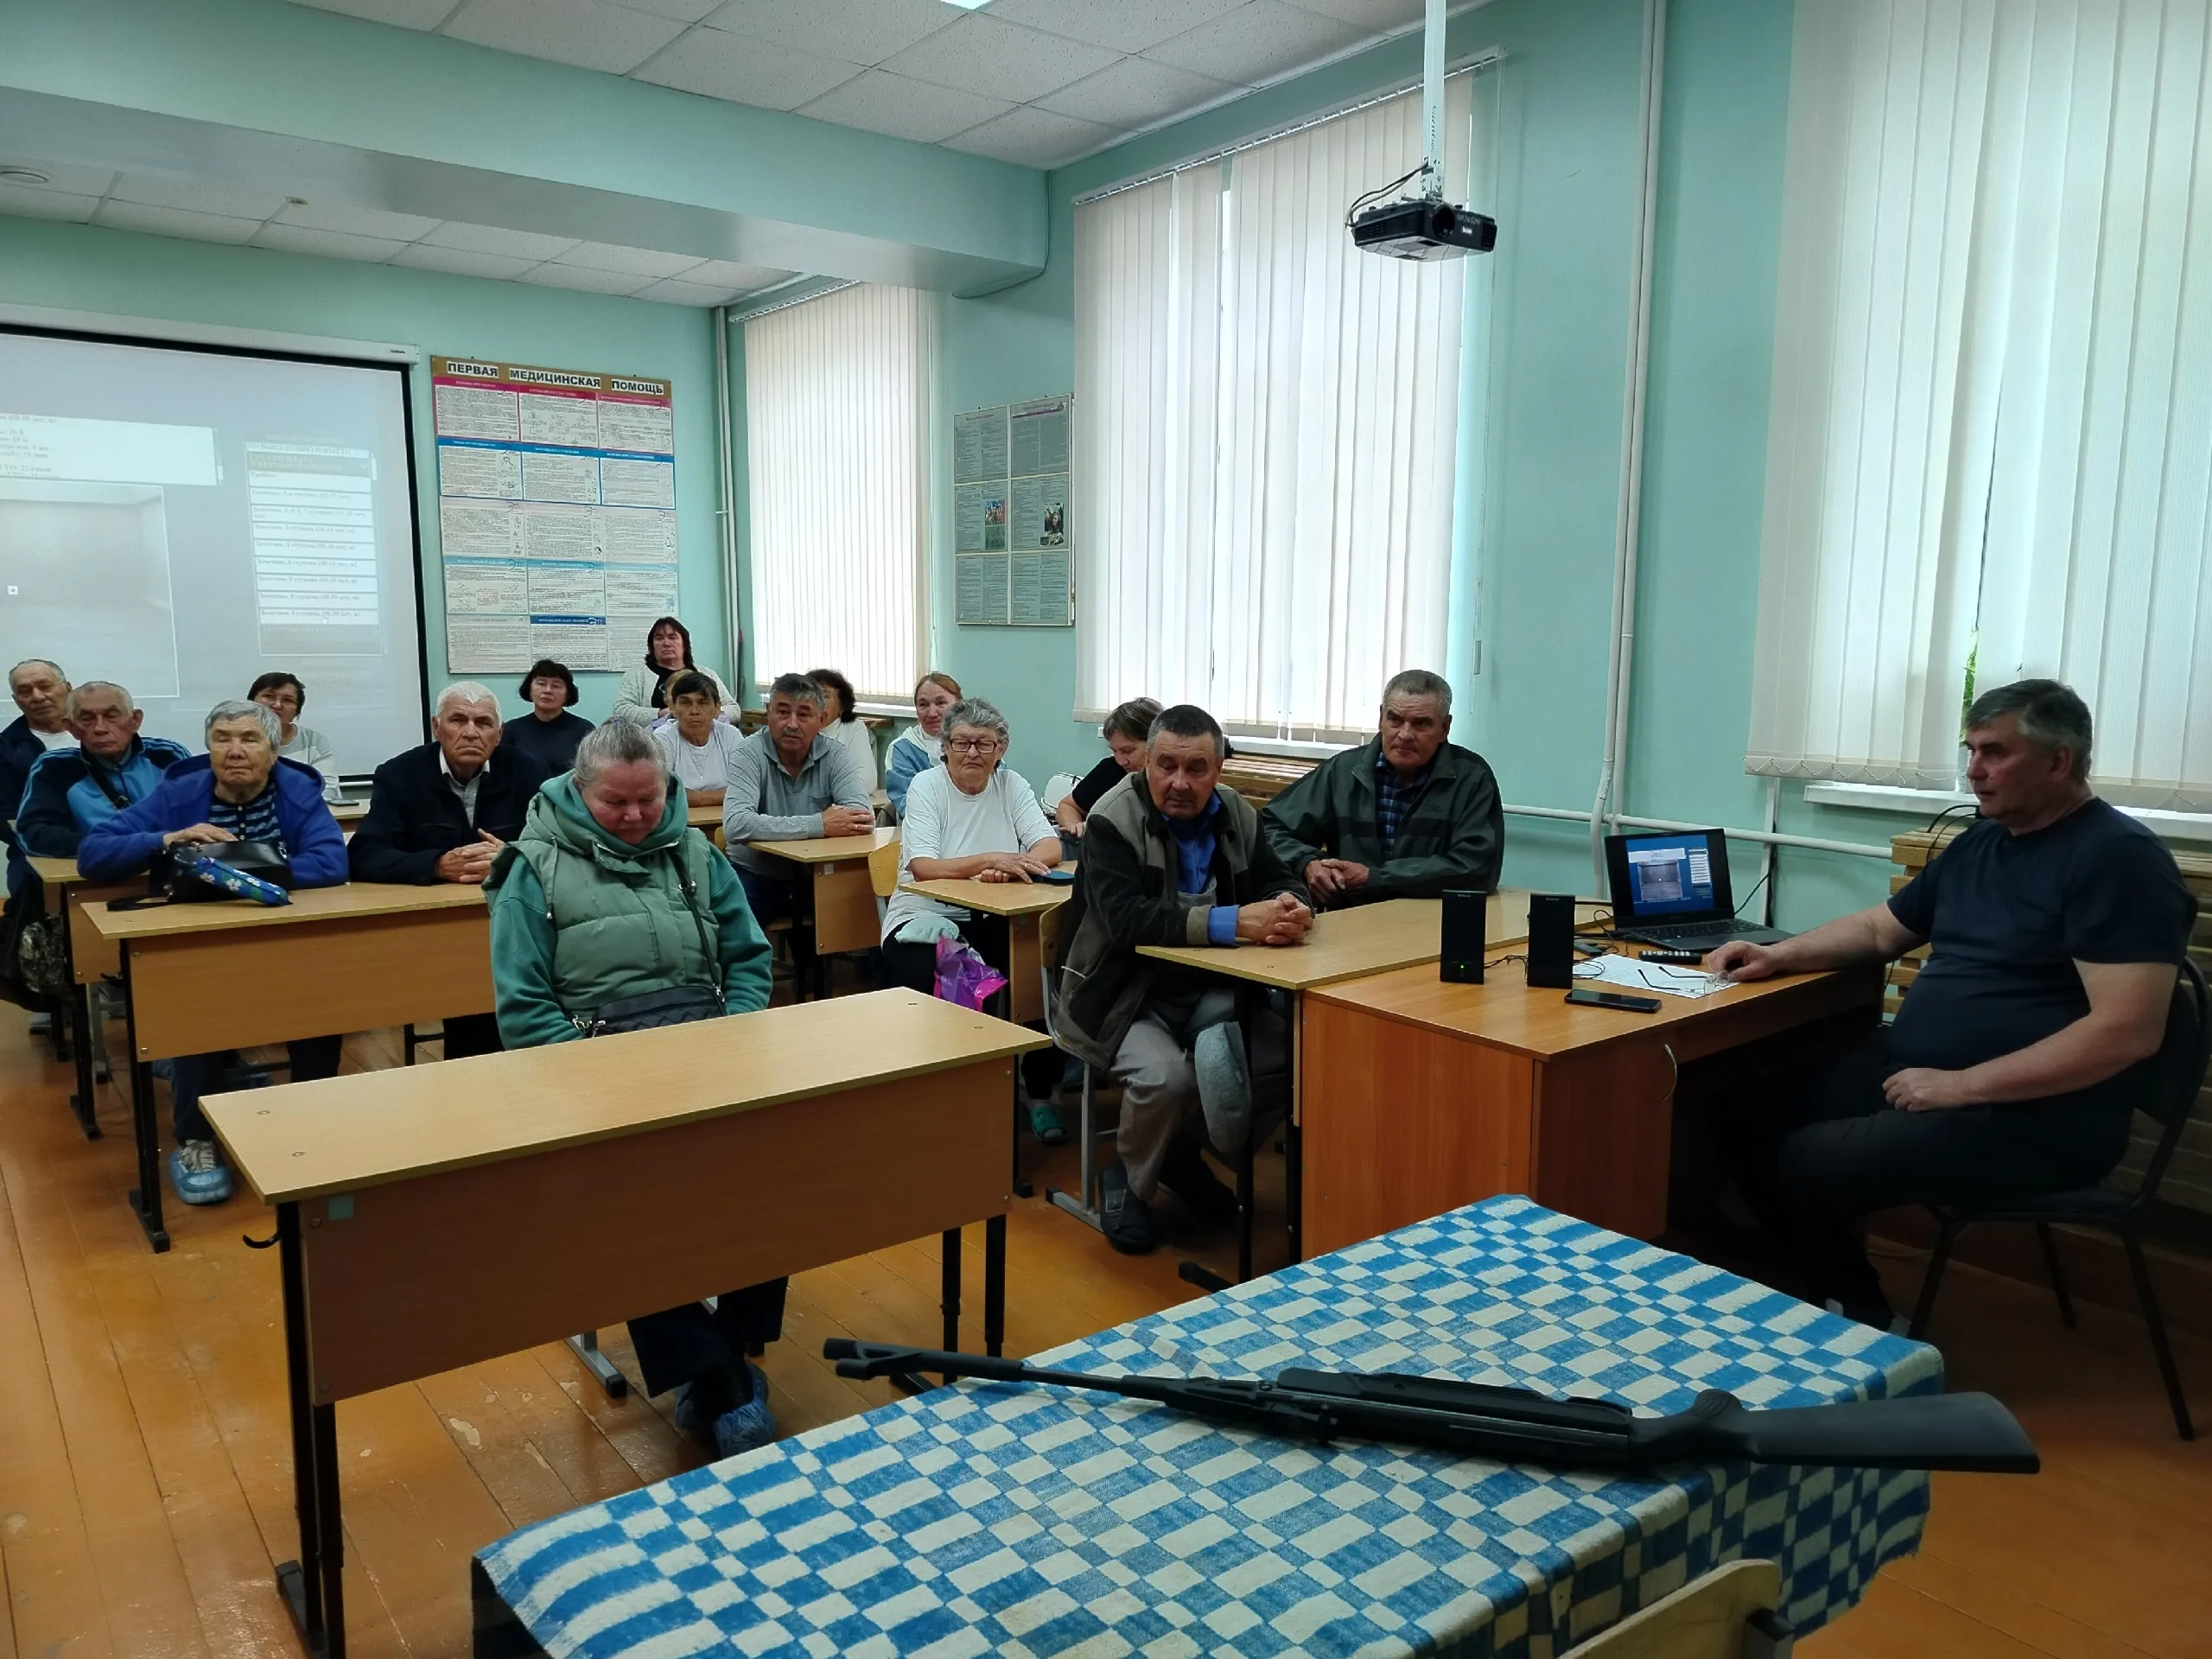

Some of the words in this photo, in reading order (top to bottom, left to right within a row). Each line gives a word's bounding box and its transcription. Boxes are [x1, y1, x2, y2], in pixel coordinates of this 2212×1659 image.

[448, 362, 498, 378] ПЕРВАЯ
[510, 369, 601, 387] МЕДИЦИНСКАЯ
[612, 380, 664, 394] ПОМОЩЬ
